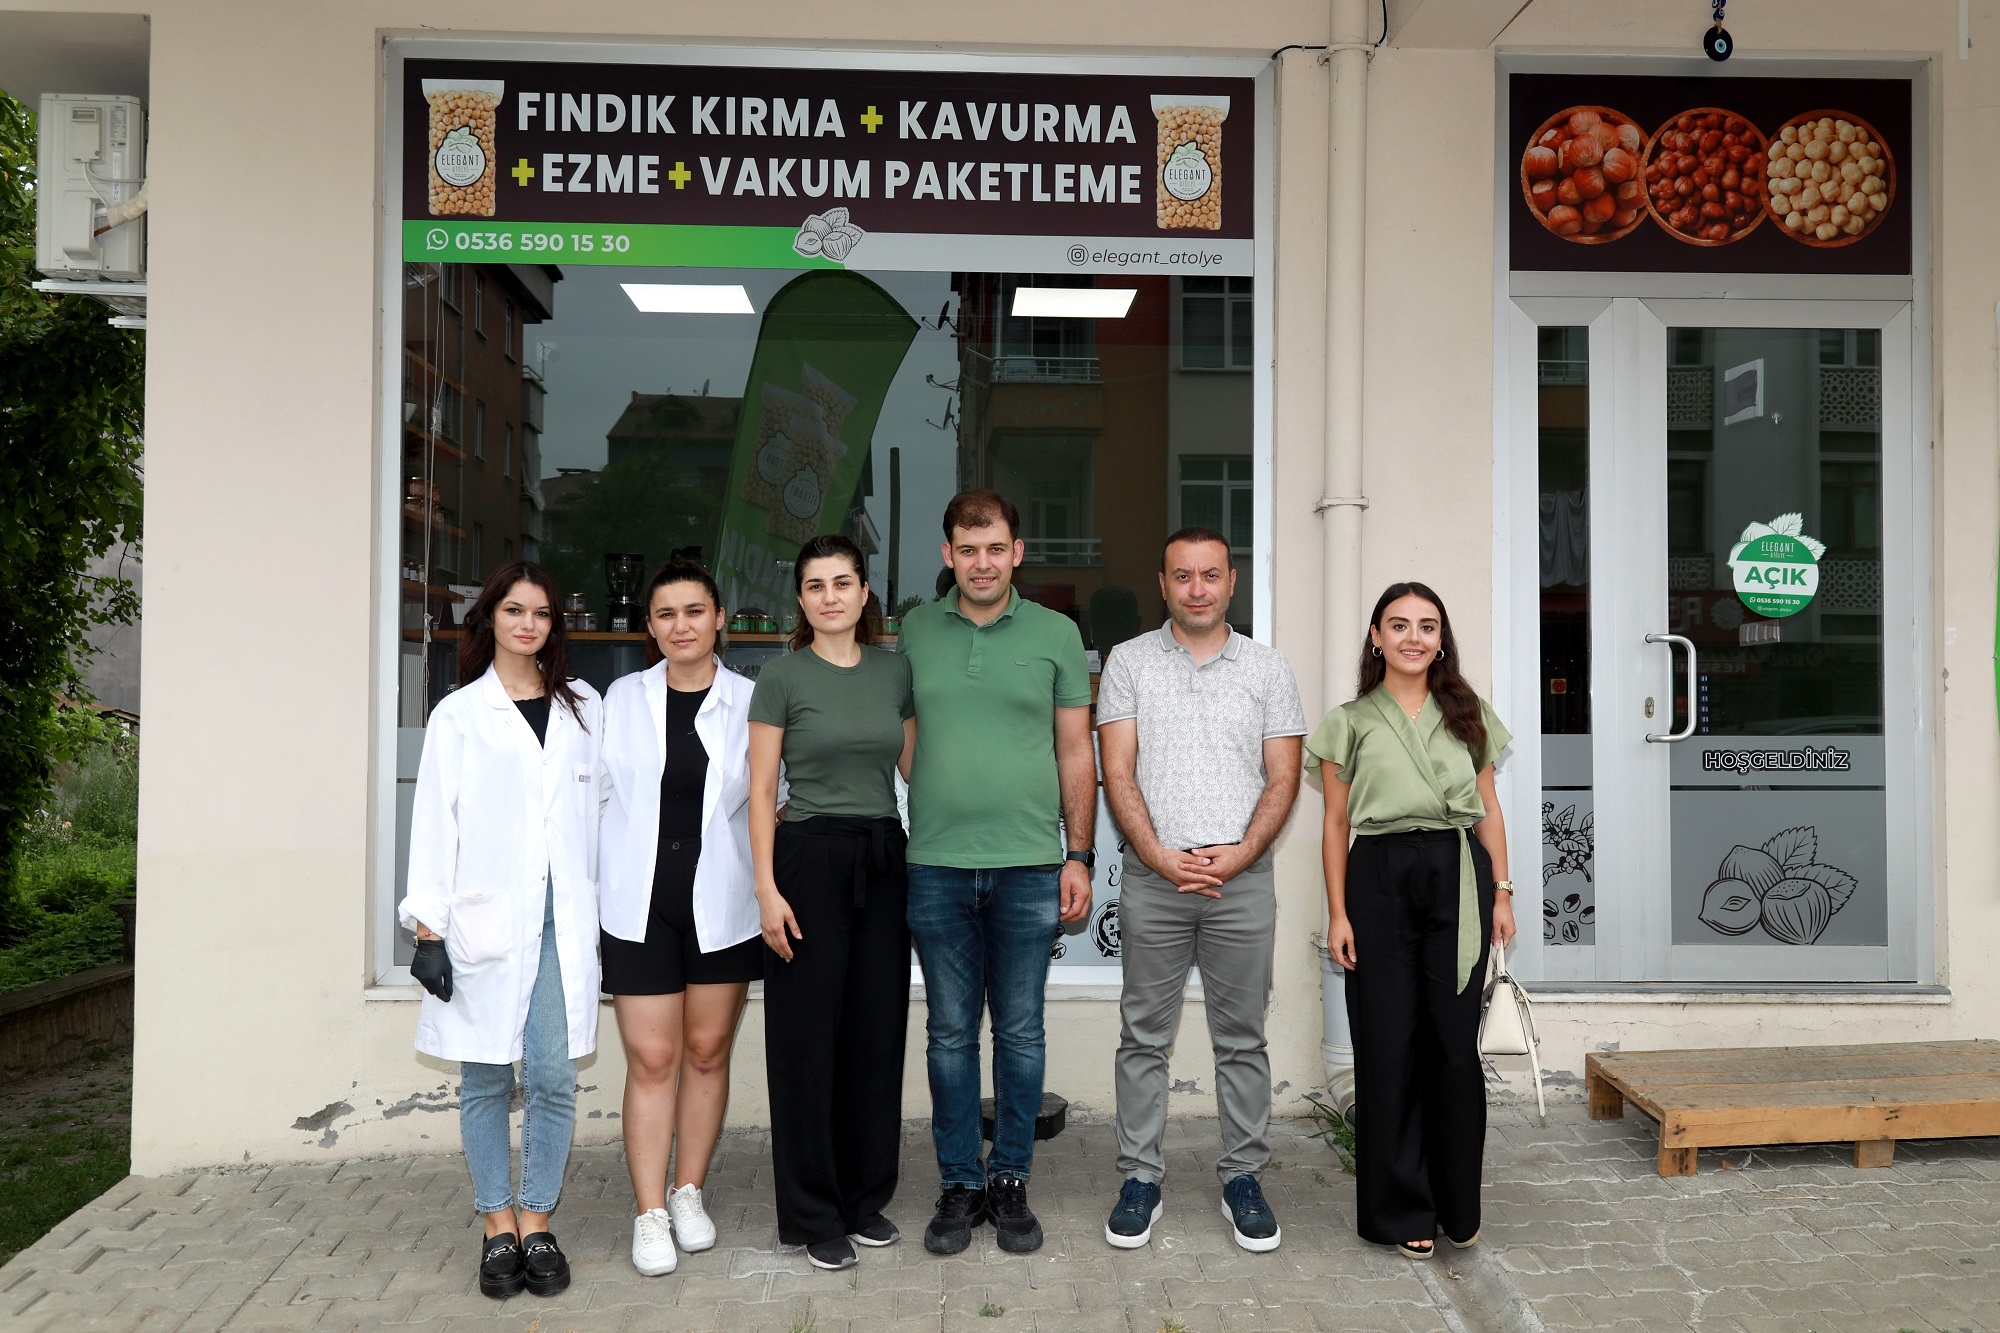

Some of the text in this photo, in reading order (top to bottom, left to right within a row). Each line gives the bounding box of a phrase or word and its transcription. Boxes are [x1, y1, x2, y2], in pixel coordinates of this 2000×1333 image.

[518, 92, 677, 135] FINDIK
[692, 95, 846, 138] KIRMA
[899, 100, 1137, 144] KAVURMA
[441, 154, 480, 166] ELEGANT
[885, 160, 1142, 204] PAKETLEME
[1169, 169, 1206, 180] ELEGANT
[455, 232, 630, 253] 0536 590 15 30
[1092, 248, 1223, 268] elegant_atolye
[1761, 541, 1795, 553] ELEGANT
[1744, 566, 1808, 590] AÇIK
[1704, 747, 1850, 774] HOŞGELDİNİZ
